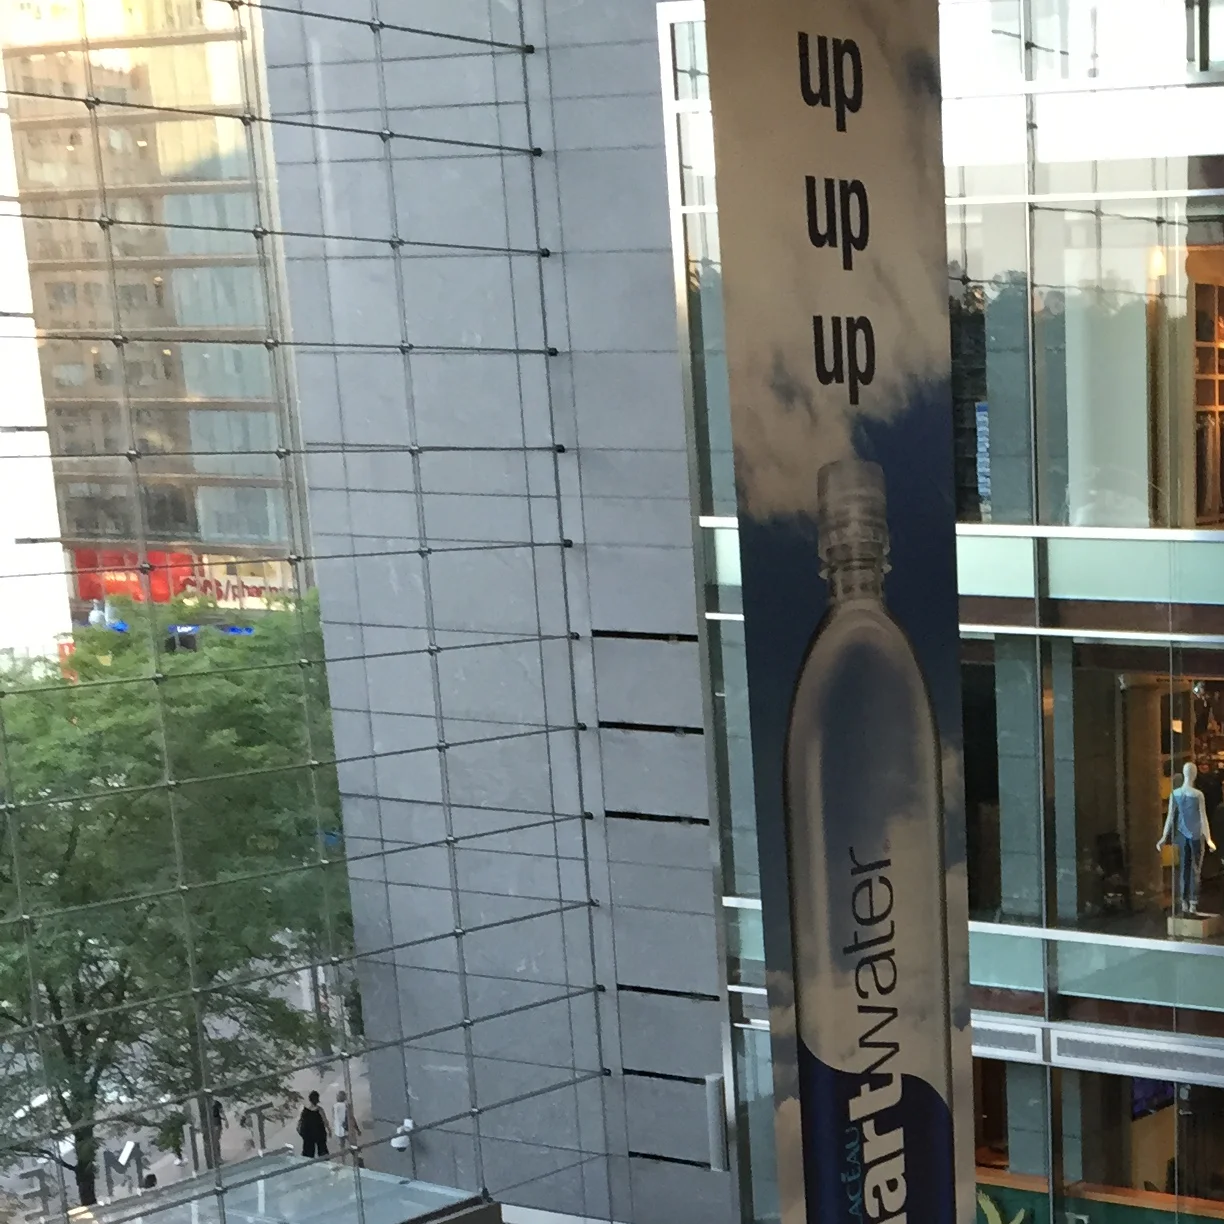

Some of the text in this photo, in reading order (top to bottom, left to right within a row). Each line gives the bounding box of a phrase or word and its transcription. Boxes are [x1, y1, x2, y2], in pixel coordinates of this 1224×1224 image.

[796, 31, 864, 132] up
[804, 175, 870, 271] up
[812, 314, 876, 405] up
